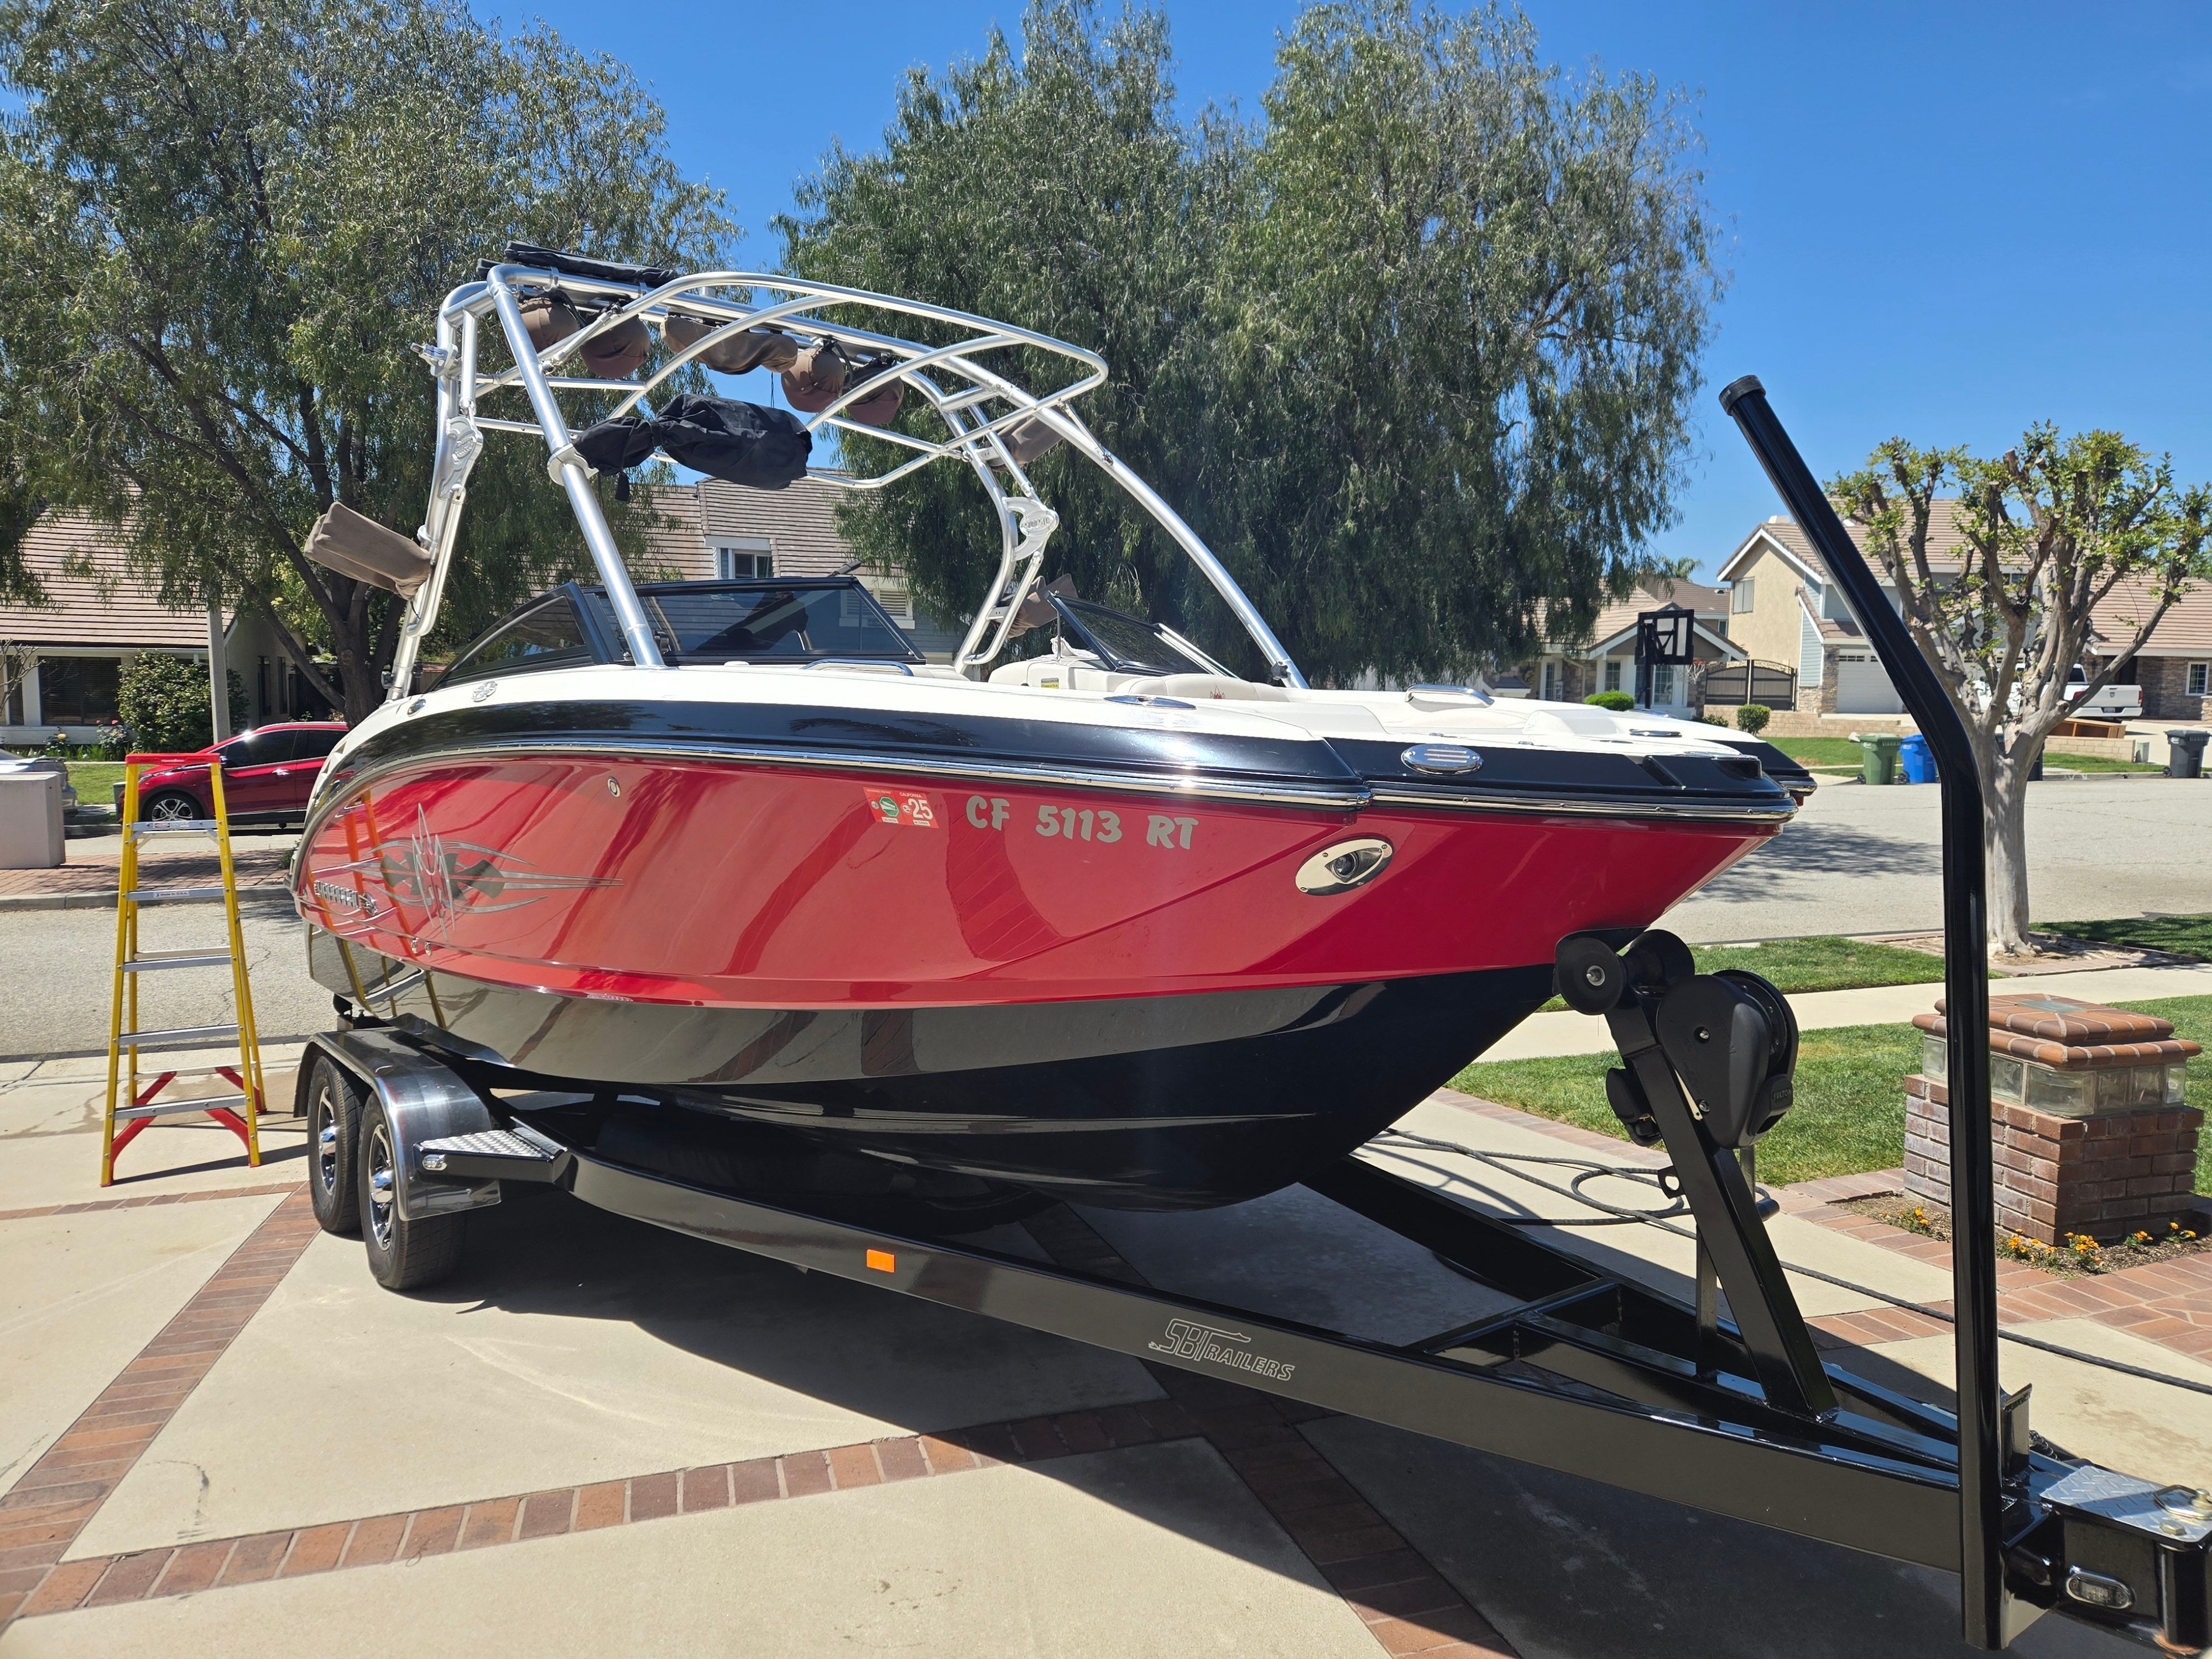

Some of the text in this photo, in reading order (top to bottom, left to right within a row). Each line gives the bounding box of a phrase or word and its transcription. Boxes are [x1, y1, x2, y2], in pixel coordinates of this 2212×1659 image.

[908, 798, 933, 820] 25
[966, 795, 1199, 849] CF 5113 RT
